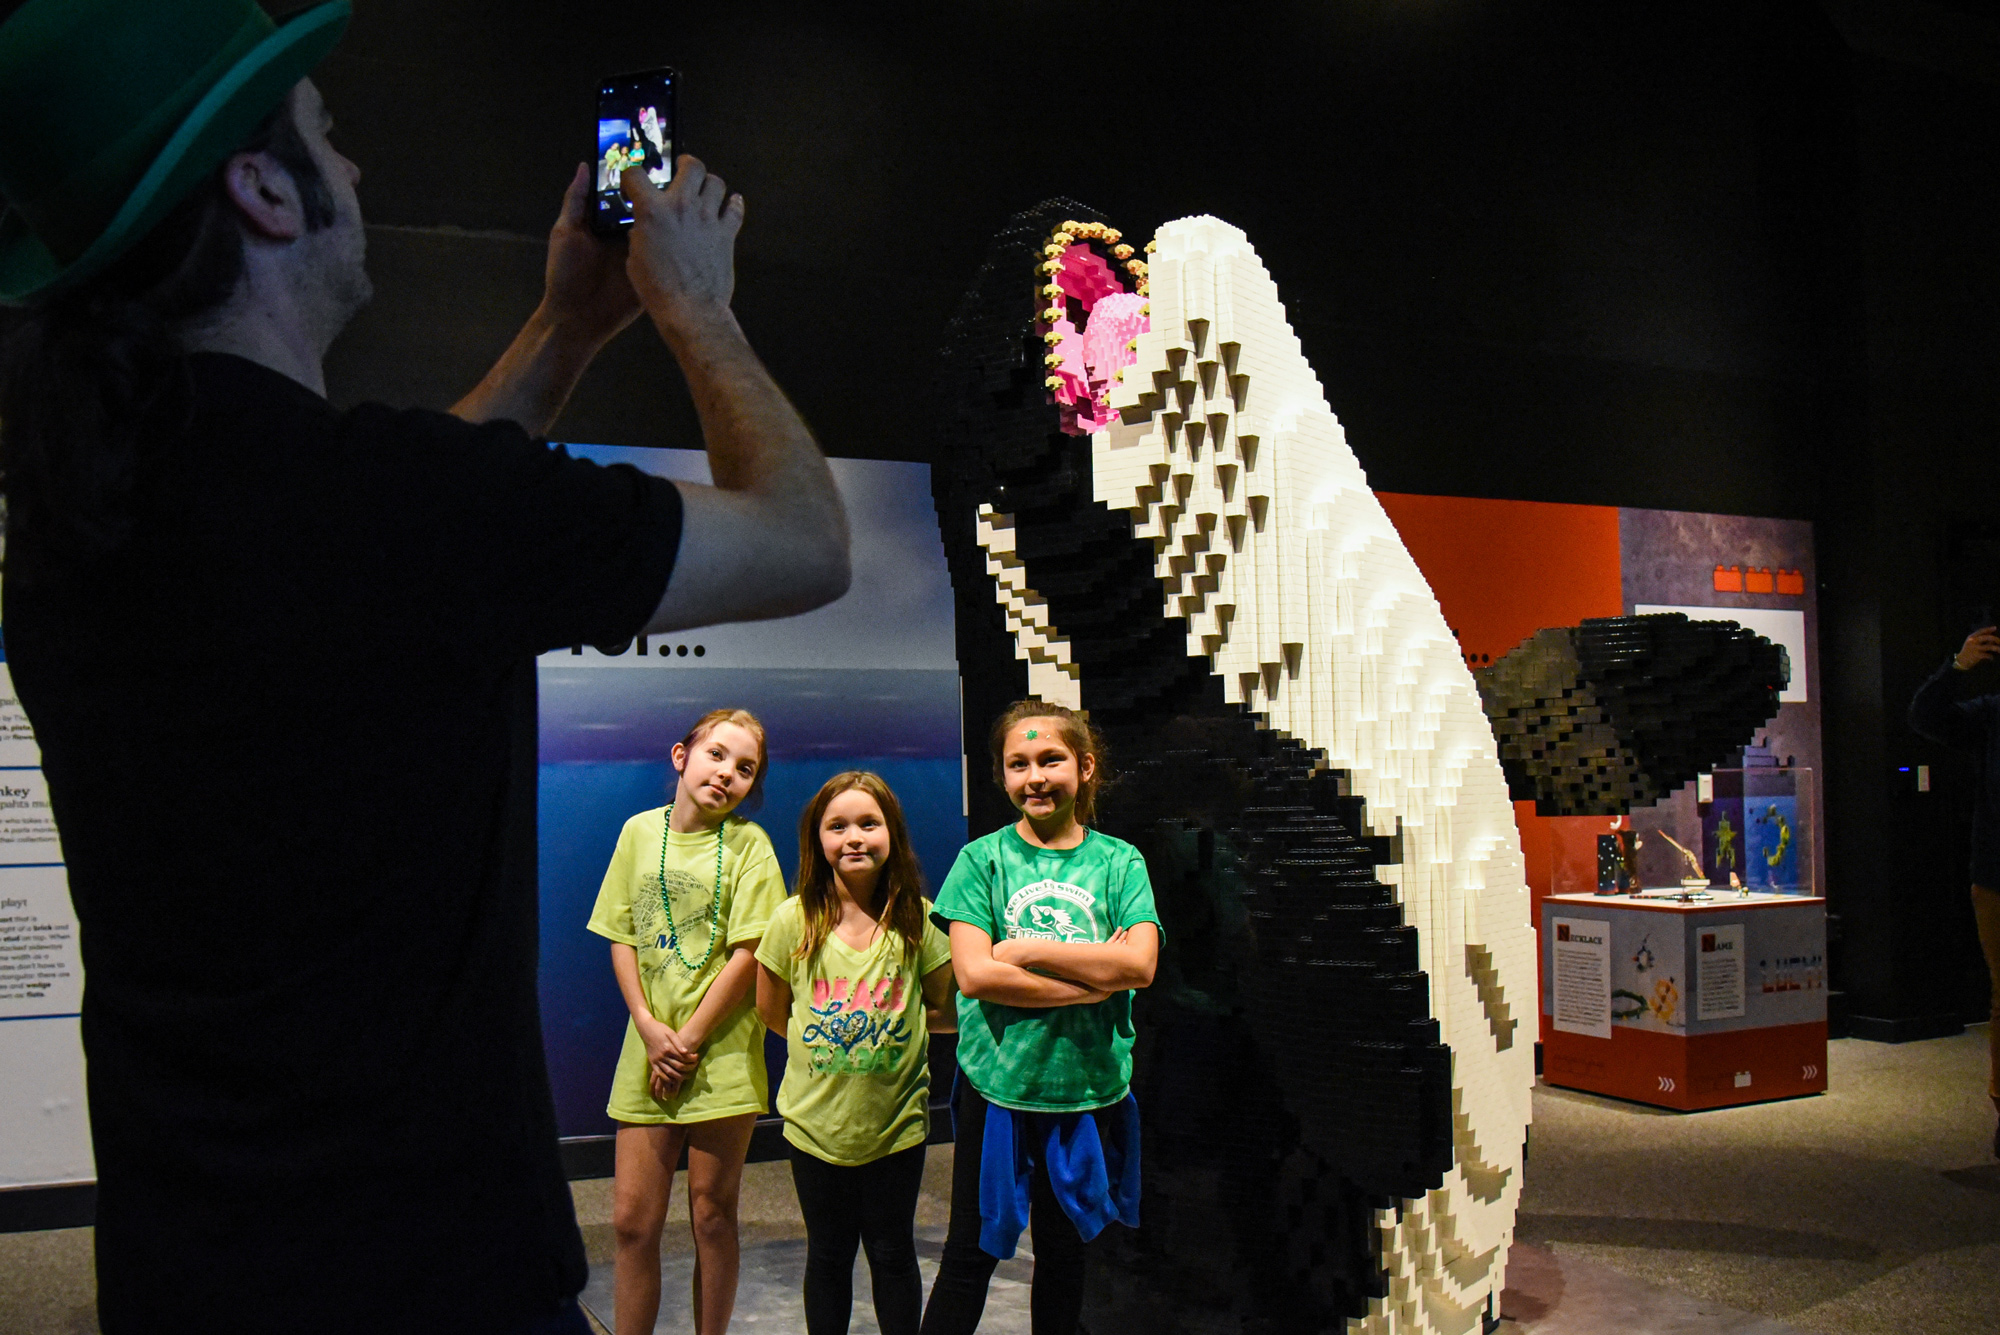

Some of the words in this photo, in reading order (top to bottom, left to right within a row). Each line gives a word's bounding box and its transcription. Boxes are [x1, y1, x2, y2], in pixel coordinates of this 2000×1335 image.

[1006, 897, 1019, 916] We
[1018, 885, 1043, 899] Live
[1056, 884, 1090, 902] Swim
[812, 978, 905, 1011] PEACE
[803, 1000, 912, 1055] Love
